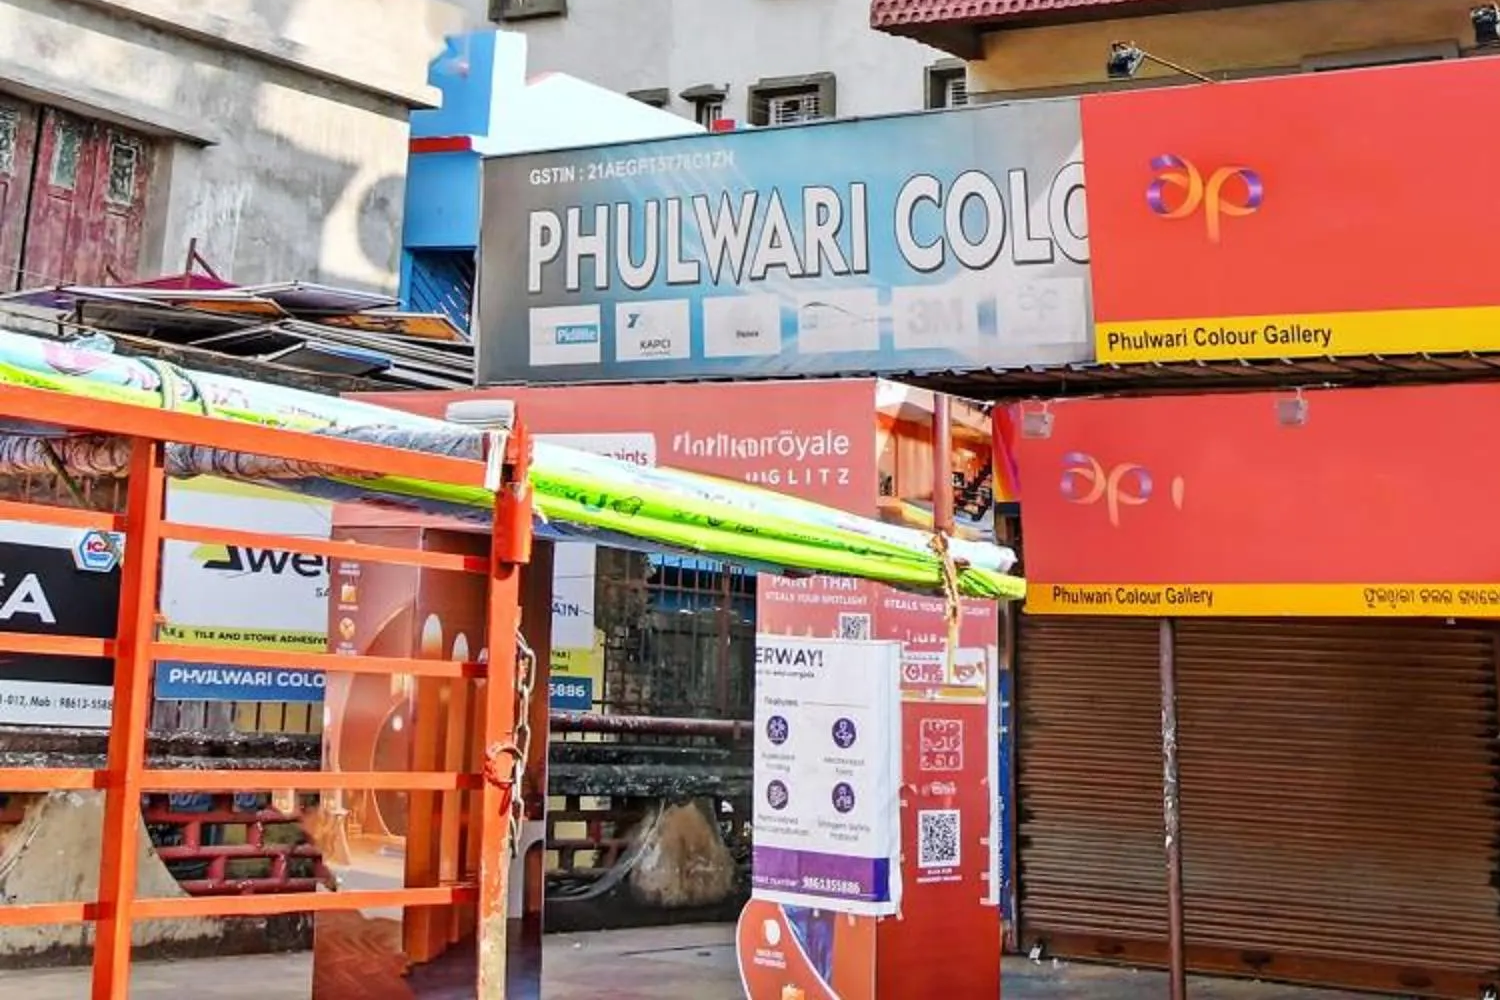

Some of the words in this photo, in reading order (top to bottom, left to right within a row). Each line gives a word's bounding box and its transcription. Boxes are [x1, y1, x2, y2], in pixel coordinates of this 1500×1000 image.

[529, 166, 575, 186] GSTIN
[528, 184, 870, 293] PHULWARI
[1107, 328, 1187, 351] Phulwari
[1193, 326, 1258, 347] Colour
[1263, 324, 1332, 348] Gallery
[1053, 585, 1112, 605] Phulwari
[1115, 586, 1162, 605] Colour
[1165, 586, 1213, 608] Gallery
[195, 630, 216, 640] TILE
[218, 631, 241, 641] AND
[243, 633, 278, 643] STONE
